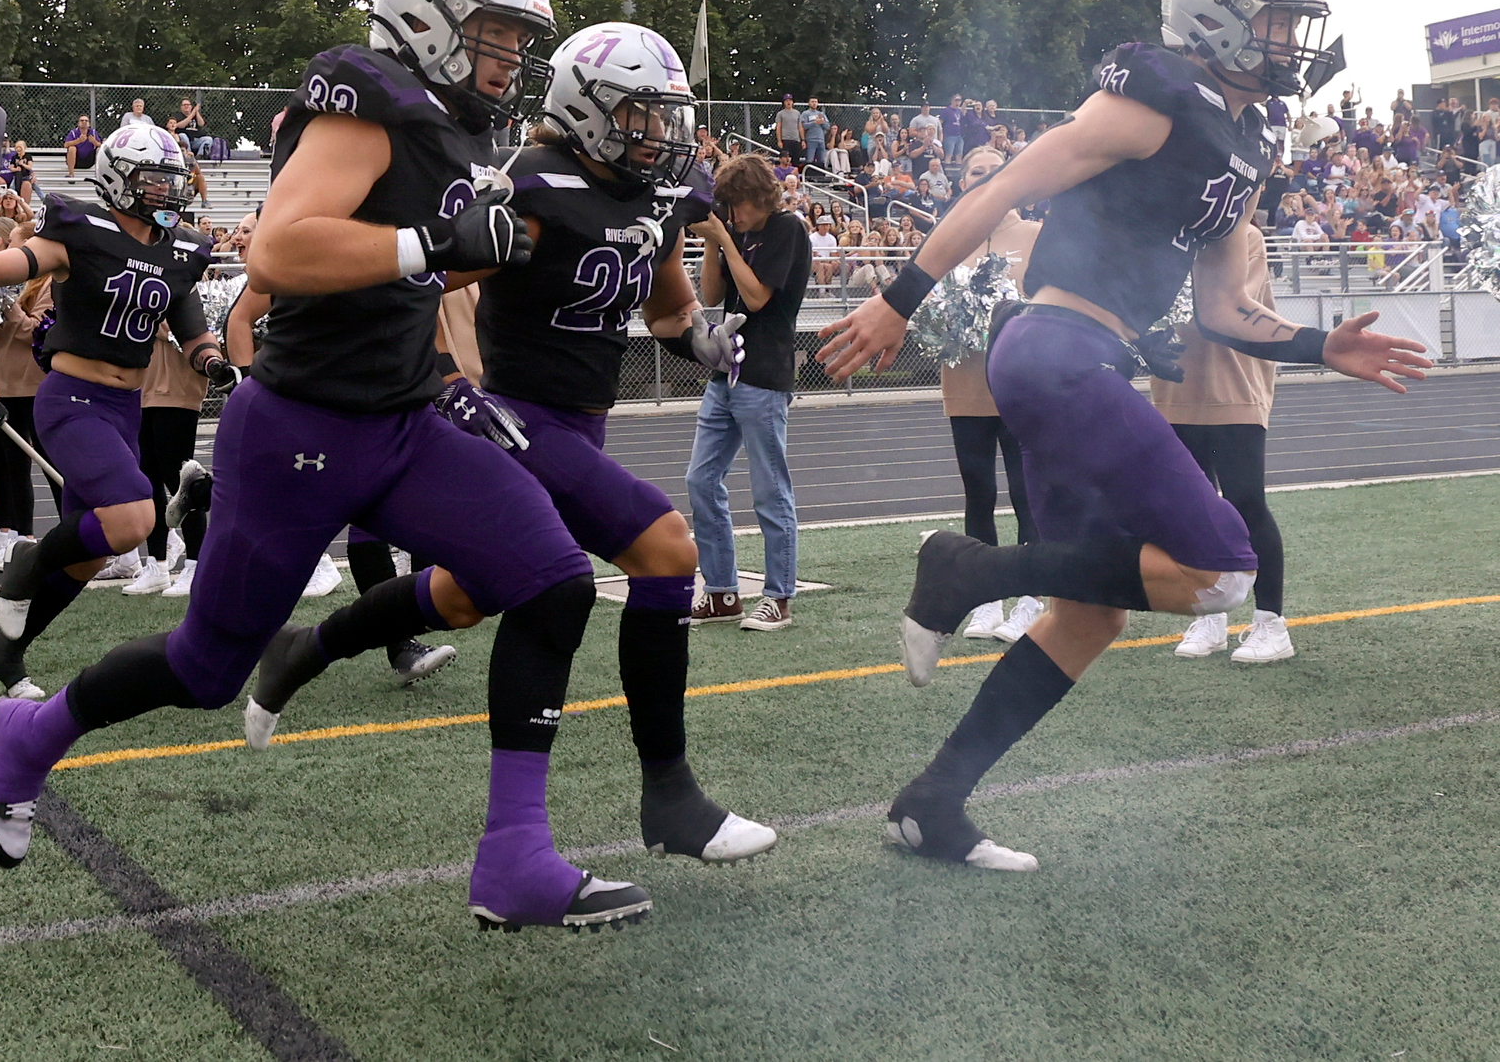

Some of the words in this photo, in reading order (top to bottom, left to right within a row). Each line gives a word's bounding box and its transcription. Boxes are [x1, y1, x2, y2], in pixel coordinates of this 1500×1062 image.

[574, 33, 622, 69] 21
[110, 129, 136, 149] 18
[1229, 153, 1258, 182] RIVERTON
[127, 258, 164, 276] RIVERTON
[550, 246, 656, 332] 21
[100, 269, 171, 343] 18
